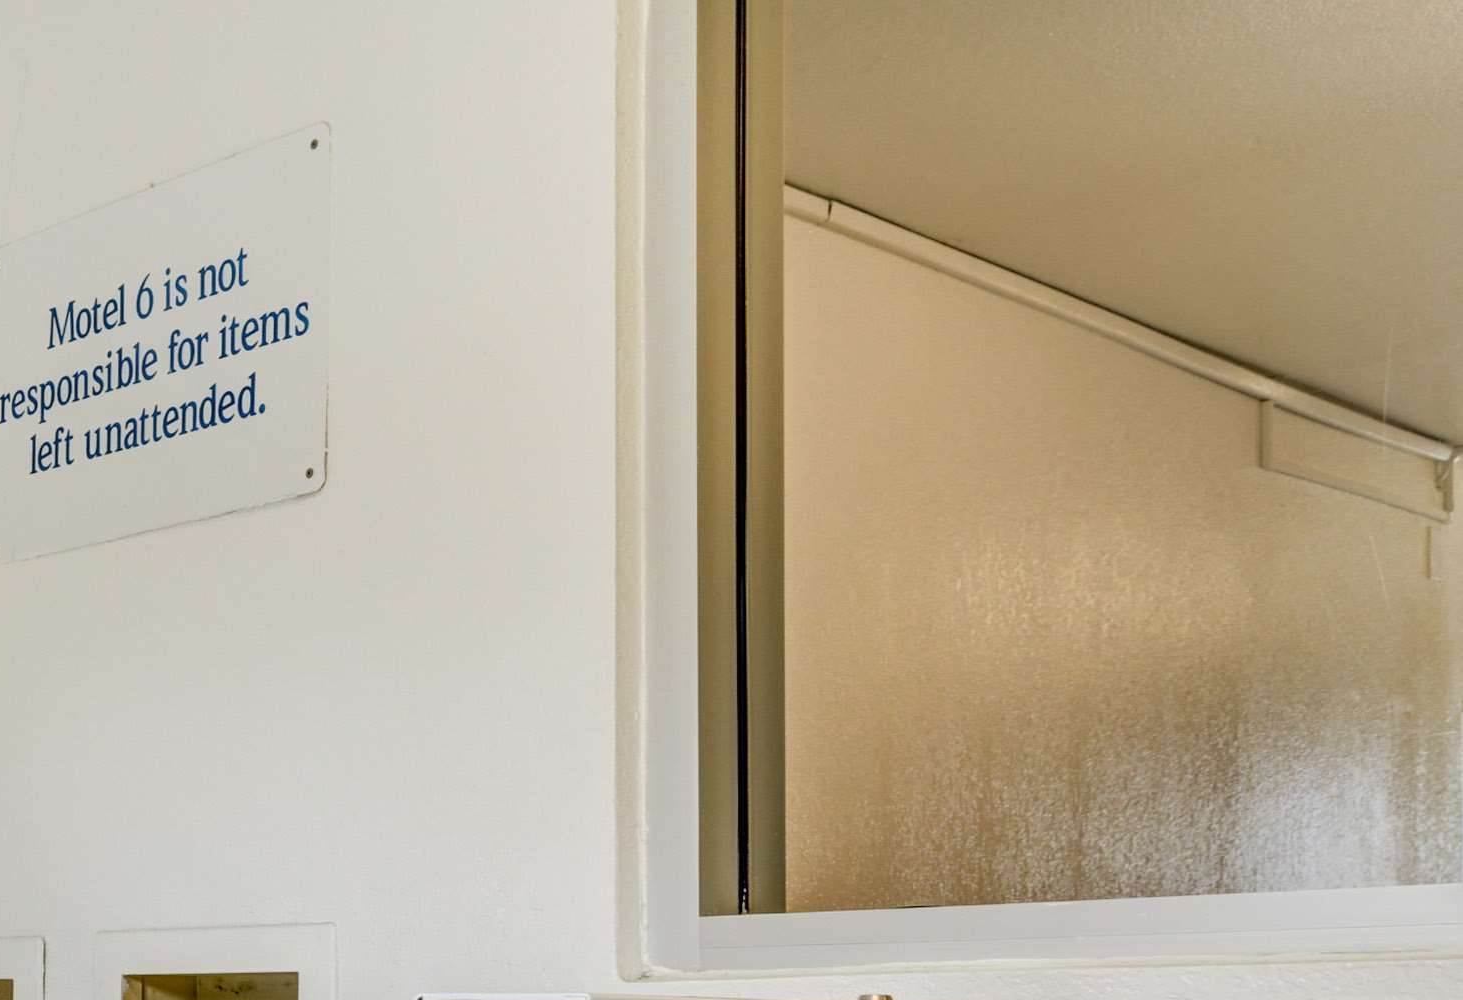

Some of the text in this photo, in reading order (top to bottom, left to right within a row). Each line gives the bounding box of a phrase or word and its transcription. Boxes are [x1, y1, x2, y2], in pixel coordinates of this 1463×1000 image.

[47, 247, 249, 349] Motel 6 is not
[0, 301, 310, 424] responsible for items
[29, 372, 267, 474] left unattended.
